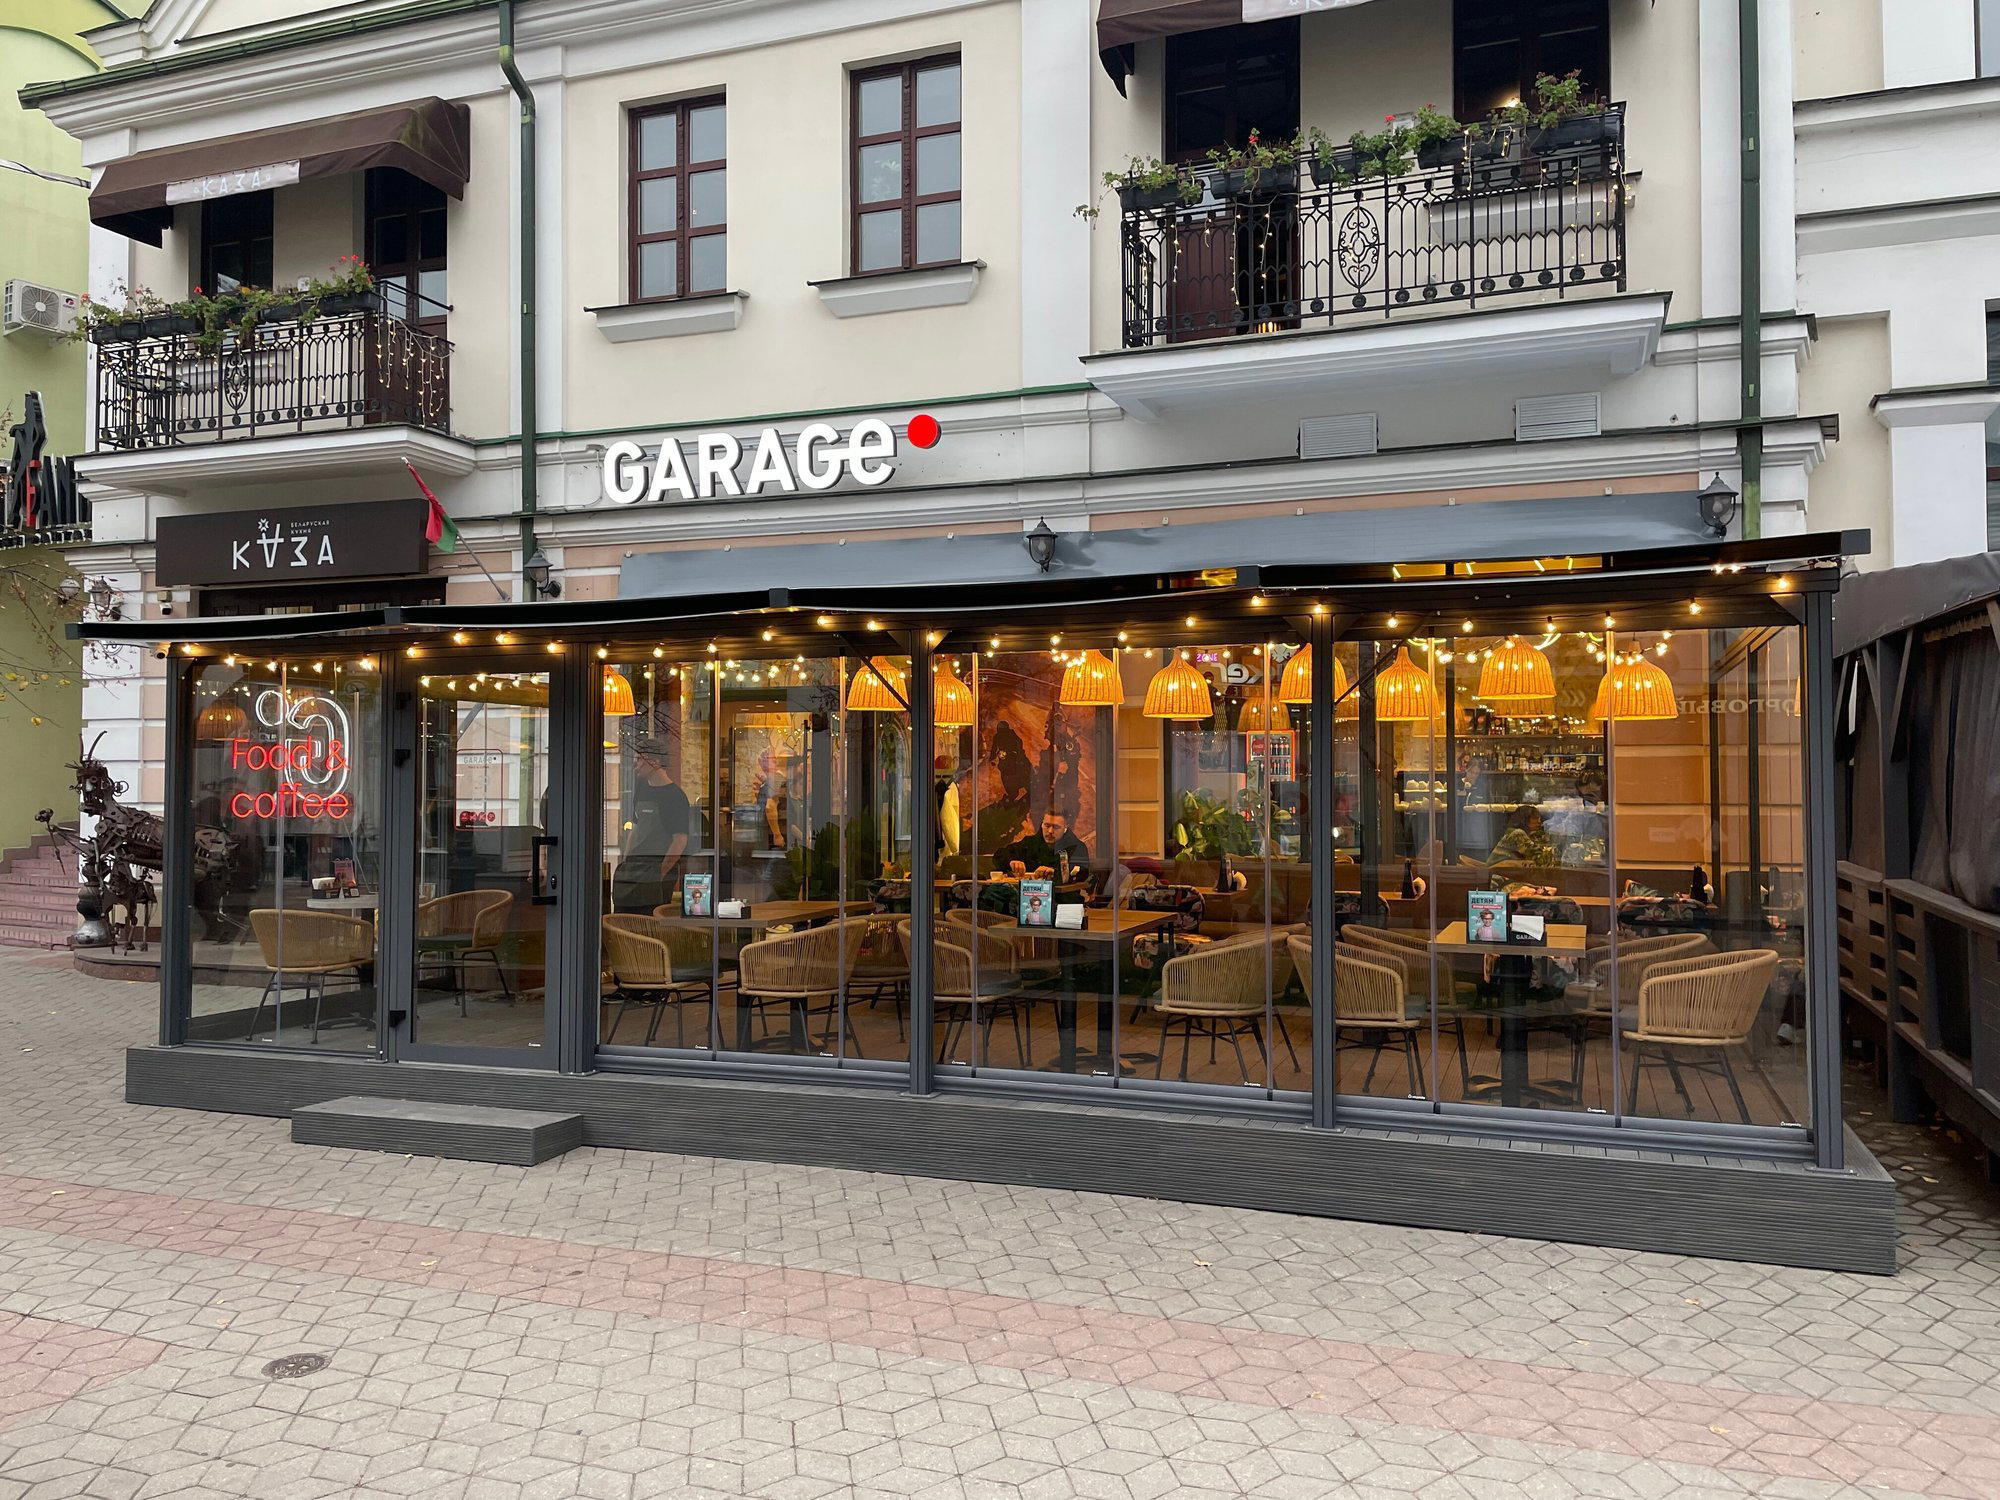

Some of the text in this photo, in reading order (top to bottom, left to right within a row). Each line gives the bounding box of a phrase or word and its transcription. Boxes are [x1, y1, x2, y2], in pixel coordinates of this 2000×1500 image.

[232, 736, 351, 772] Food &
[231, 782, 350, 819] coffee
